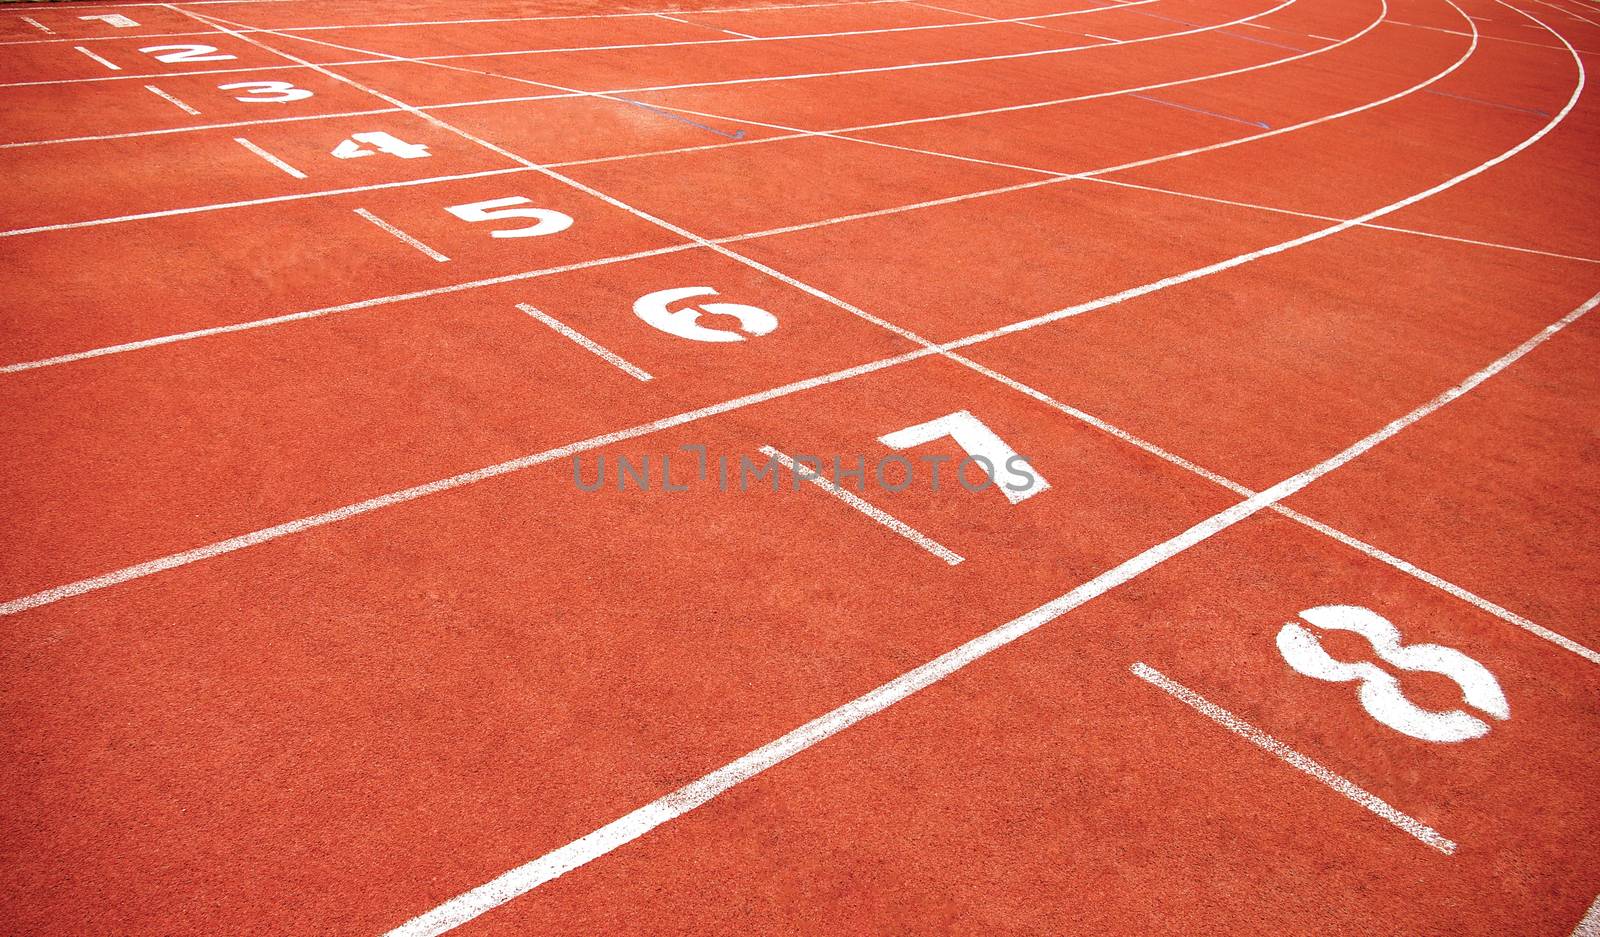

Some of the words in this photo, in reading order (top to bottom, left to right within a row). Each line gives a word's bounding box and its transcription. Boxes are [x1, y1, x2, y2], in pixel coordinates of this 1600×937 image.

[78, 13, 141, 28] 1
[138, 44, 238, 63] 2
[218, 81, 314, 103] 3
[330, 130, 432, 159] 4
[444, 196, 575, 238] 5
[632, 285, 778, 342] 6
[878, 409, 1051, 505] 7
[1276, 604, 1511, 742] 8
